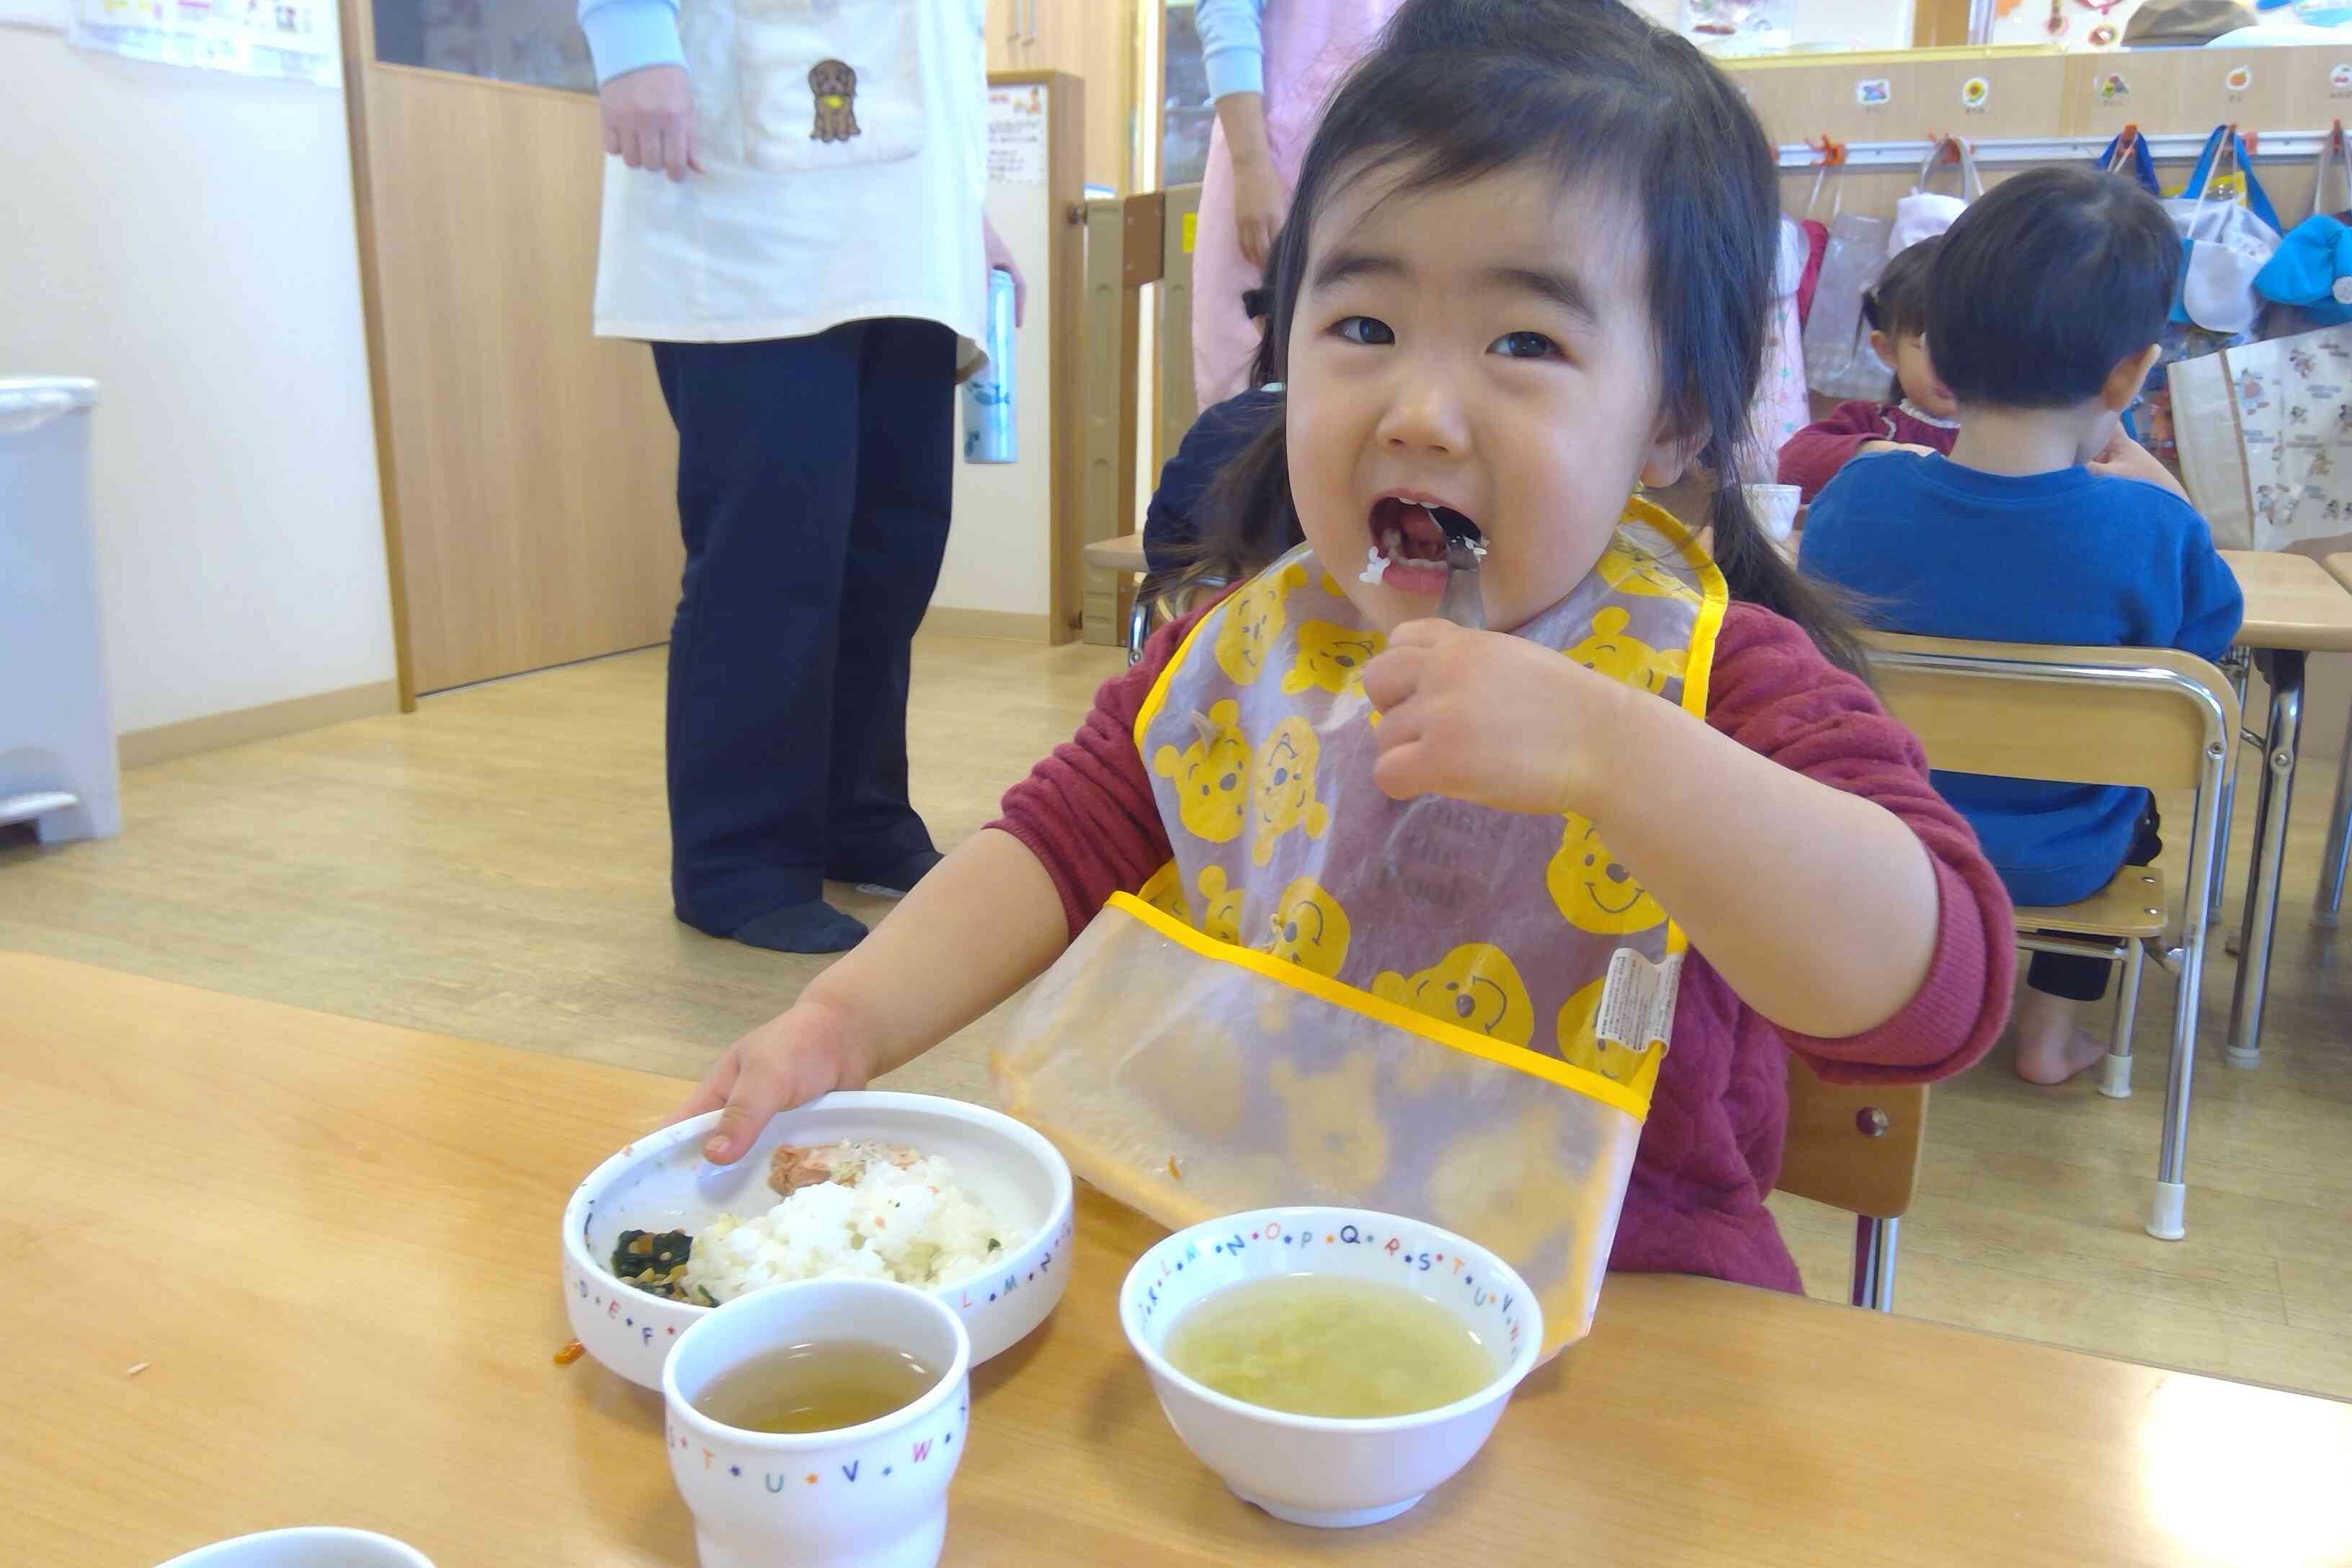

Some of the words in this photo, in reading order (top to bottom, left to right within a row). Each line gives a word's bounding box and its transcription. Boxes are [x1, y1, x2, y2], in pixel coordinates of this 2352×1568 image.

[641, 1327, 655, 1346] F
[962, 1291, 974, 1309] L
[1040, 1251, 1052, 1273] N
[1226, 1234, 1246, 1257] N
[1265, 1222, 1281, 1240] O
[1301, 1231, 1312, 1249] P
[1340, 1224, 1361, 1244] Q
[1384, 1237, 1400, 1257] R
[1418, 1252, 1431, 1271] S
[1453, 1256, 1465, 1277] T
[1474, 1286, 1488, 1307] U
[1502, 1293, 1514, 1314] V
[764, 1473, 785, 1494] U
[842, 1458, 860, 1483] V
[913, 1437, 935, 1464] W
